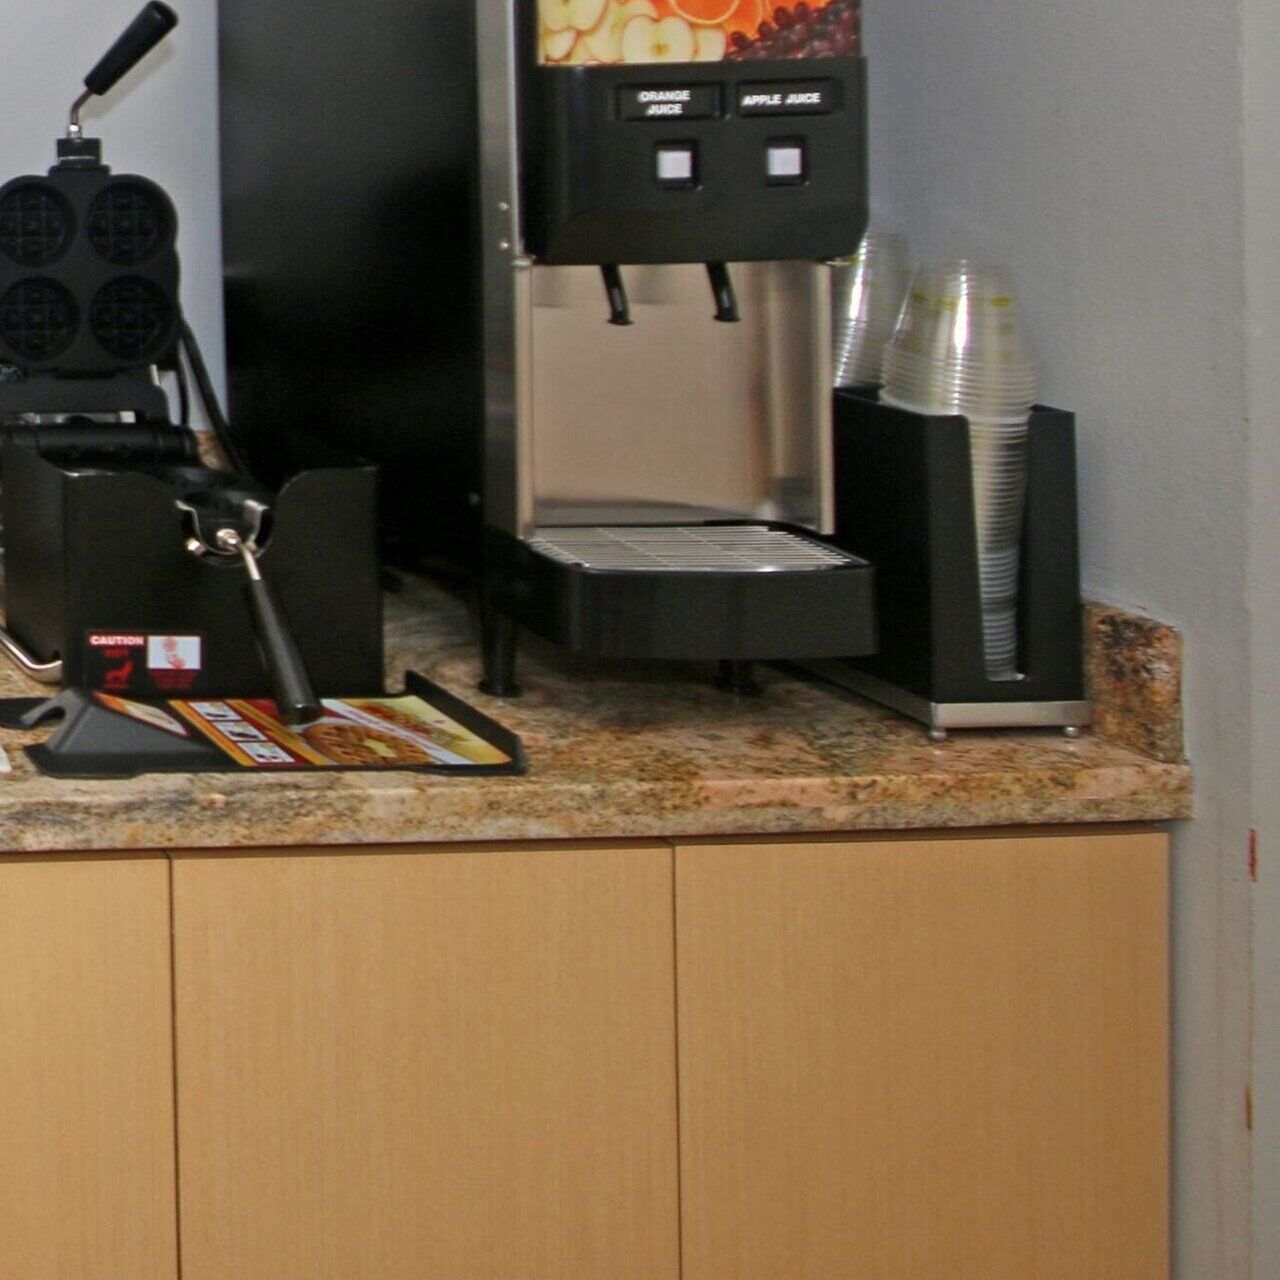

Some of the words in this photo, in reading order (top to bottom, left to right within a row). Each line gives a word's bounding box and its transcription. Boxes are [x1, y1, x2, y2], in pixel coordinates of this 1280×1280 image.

[637, 90, 691, 102] ORANGE
[742, 94, 782, 106] APPLE
[784, 92, 821, 105] JUICE
[646, 103, 683, 116] JUICE
[90, 635, 144, 646] CAUTION
